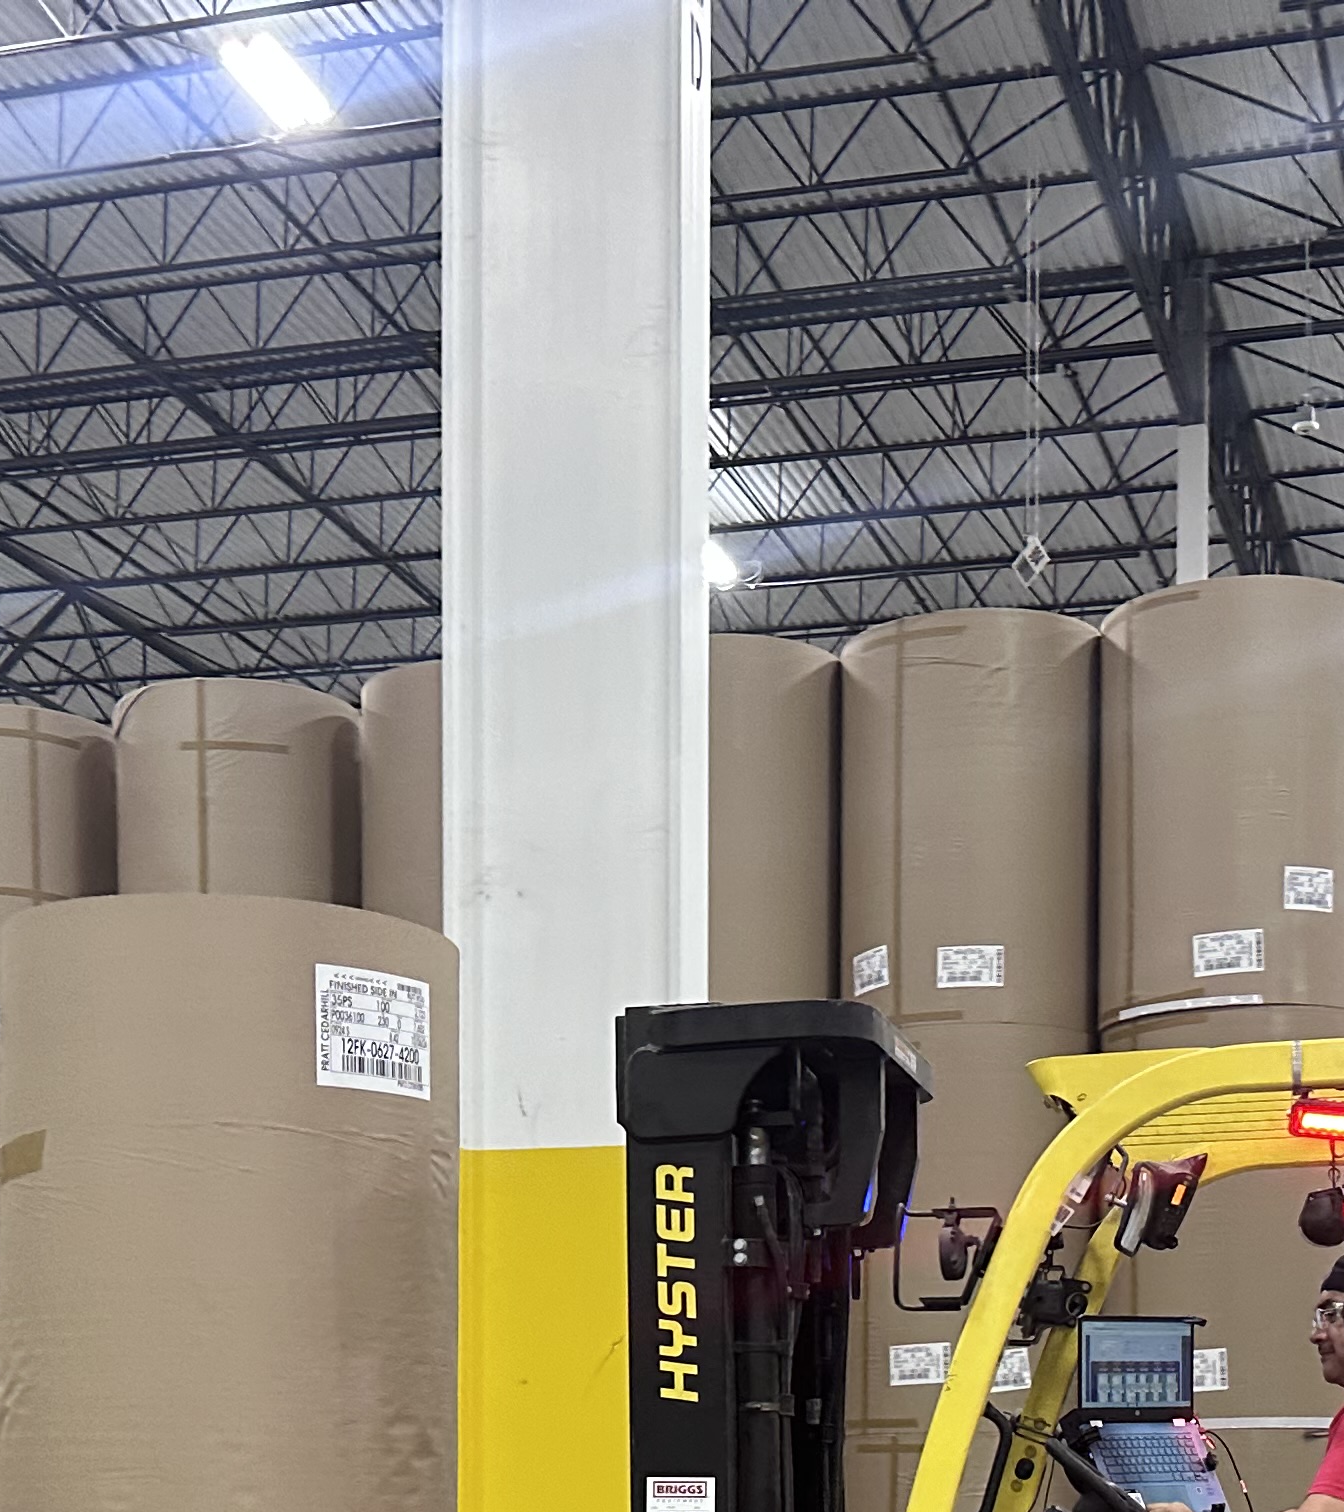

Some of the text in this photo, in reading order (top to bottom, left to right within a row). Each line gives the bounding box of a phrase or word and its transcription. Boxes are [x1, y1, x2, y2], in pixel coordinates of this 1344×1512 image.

[329, 980, 369, 993] FINISHED
[370, 986, 388, 997] SIDE
[320, 989, 330, 1072] PRATT CEDARHILL
[341, 1037, 420, 1065] 12FK-0627-4200
[655, 1163, 699, 1403] HYSTER
[656, 1485, 704, 1494] BRIGGS
